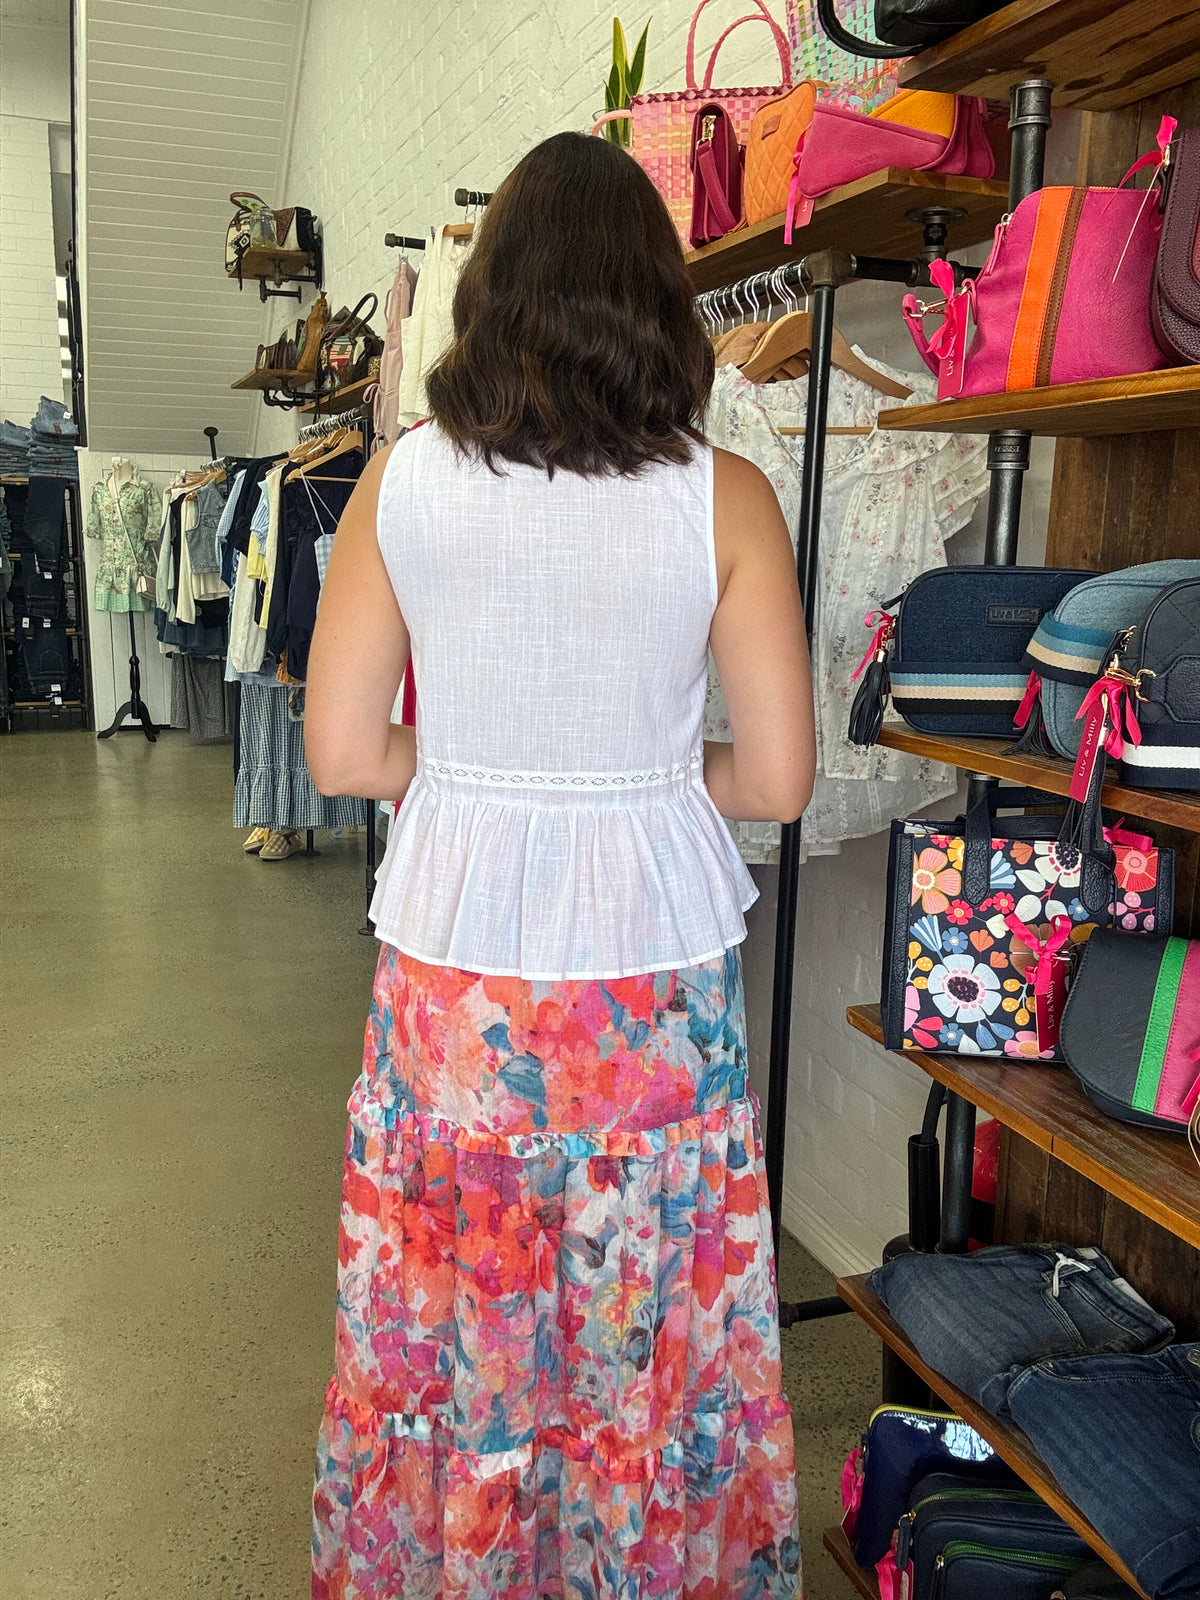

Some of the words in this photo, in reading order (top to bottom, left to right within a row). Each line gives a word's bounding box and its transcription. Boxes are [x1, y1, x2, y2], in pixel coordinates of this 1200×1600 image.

[946, 360, 954, 376] Liv
[1079, 761, 1087, 776] Liv
[1086, 716, 1097, 745] Milly
[1047, 1004, 1055, 1012] &
[1047, 1014, 1055, 1029] Liv
